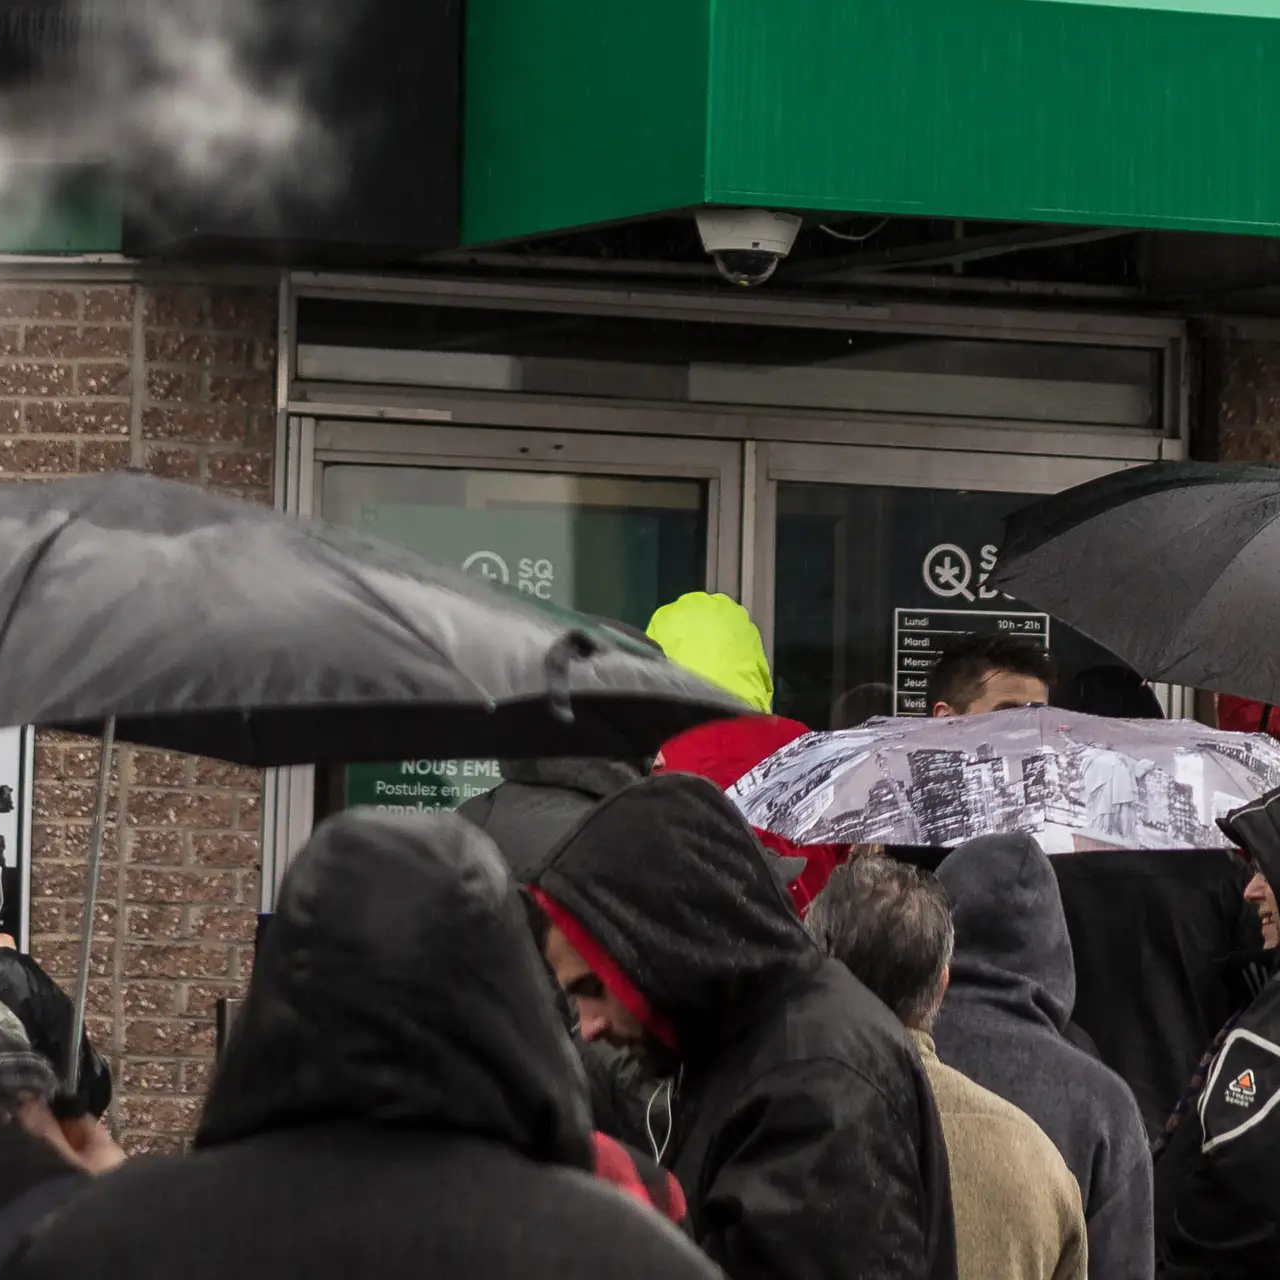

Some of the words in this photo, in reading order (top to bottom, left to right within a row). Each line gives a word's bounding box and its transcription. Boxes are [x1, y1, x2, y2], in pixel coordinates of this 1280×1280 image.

[518, 557, 554, 580] SQ
[904, 617, 929, 626] Lundi
[903, 678, 928, 687] Jeud
[401, 759, 458, 776] NOUS
[376, 781, 438, 796] Postulez
[440, 786, 460, 797] en
